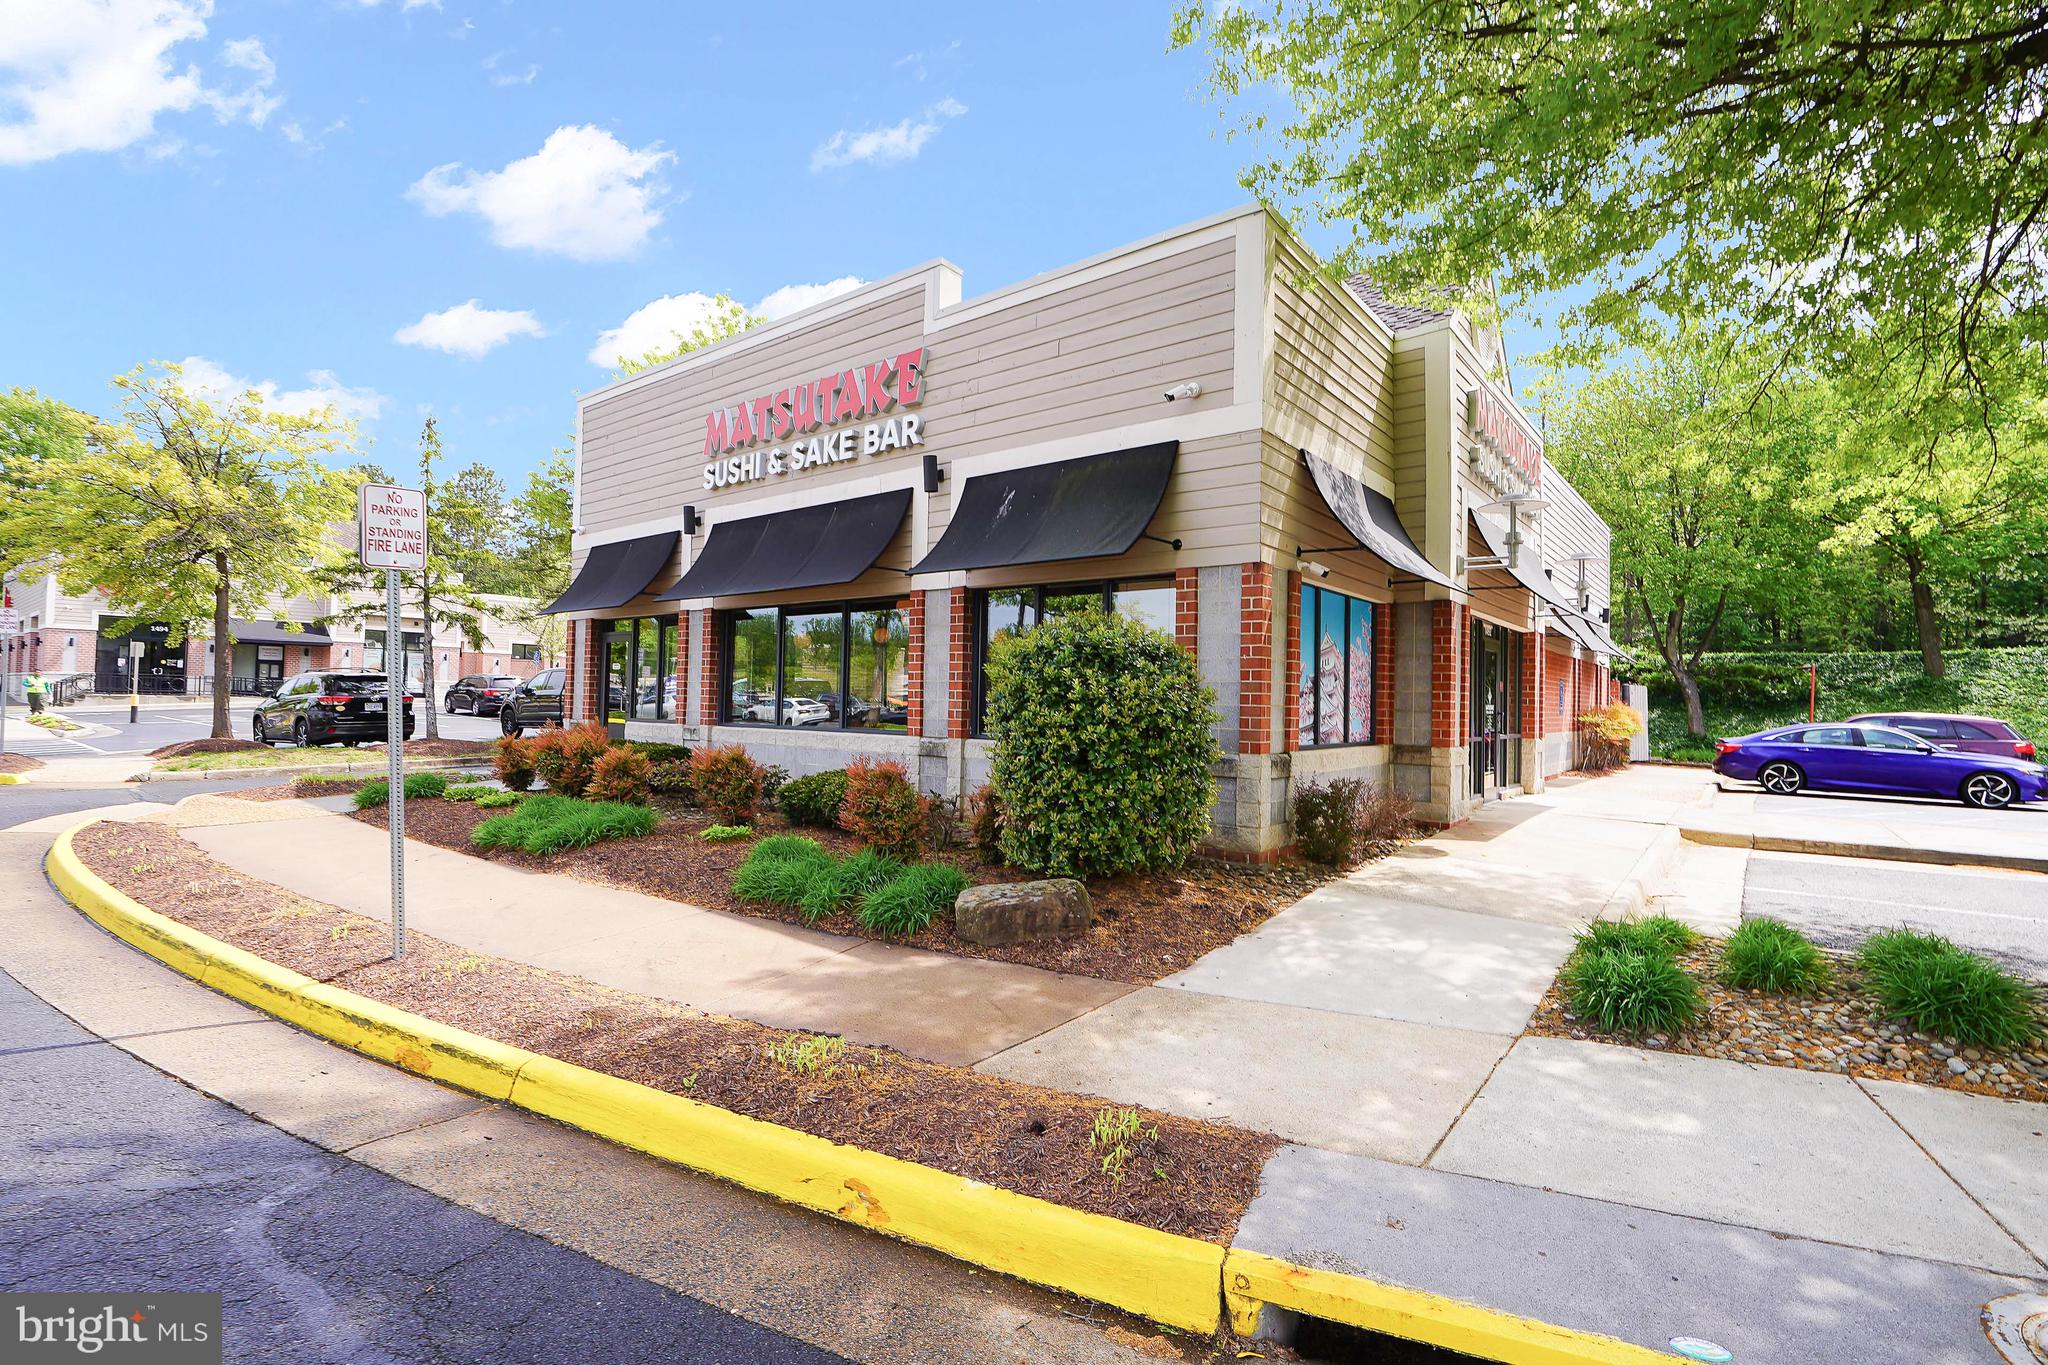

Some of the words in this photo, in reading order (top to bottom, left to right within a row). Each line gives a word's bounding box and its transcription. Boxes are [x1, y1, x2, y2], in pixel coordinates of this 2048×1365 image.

[703, 347, 929, 457] MATSUTAKE
[703, 451, 767, 490] SUSHI
[767, 448, 788, 475] &
[790, 429, 858, 472] SAKE
[863, 414, 925, 455] BAR
[387, 493, 402, 504] NO
[371, 504, 418, 518] PARKING
[389, 518, 402, 527] OR
[368, 526, 422, 540] STANDING
[367, 539, 392, 552] FIRE
[395, 541, 422, 555] LANE
[150, 625, 169, 633] 1494
